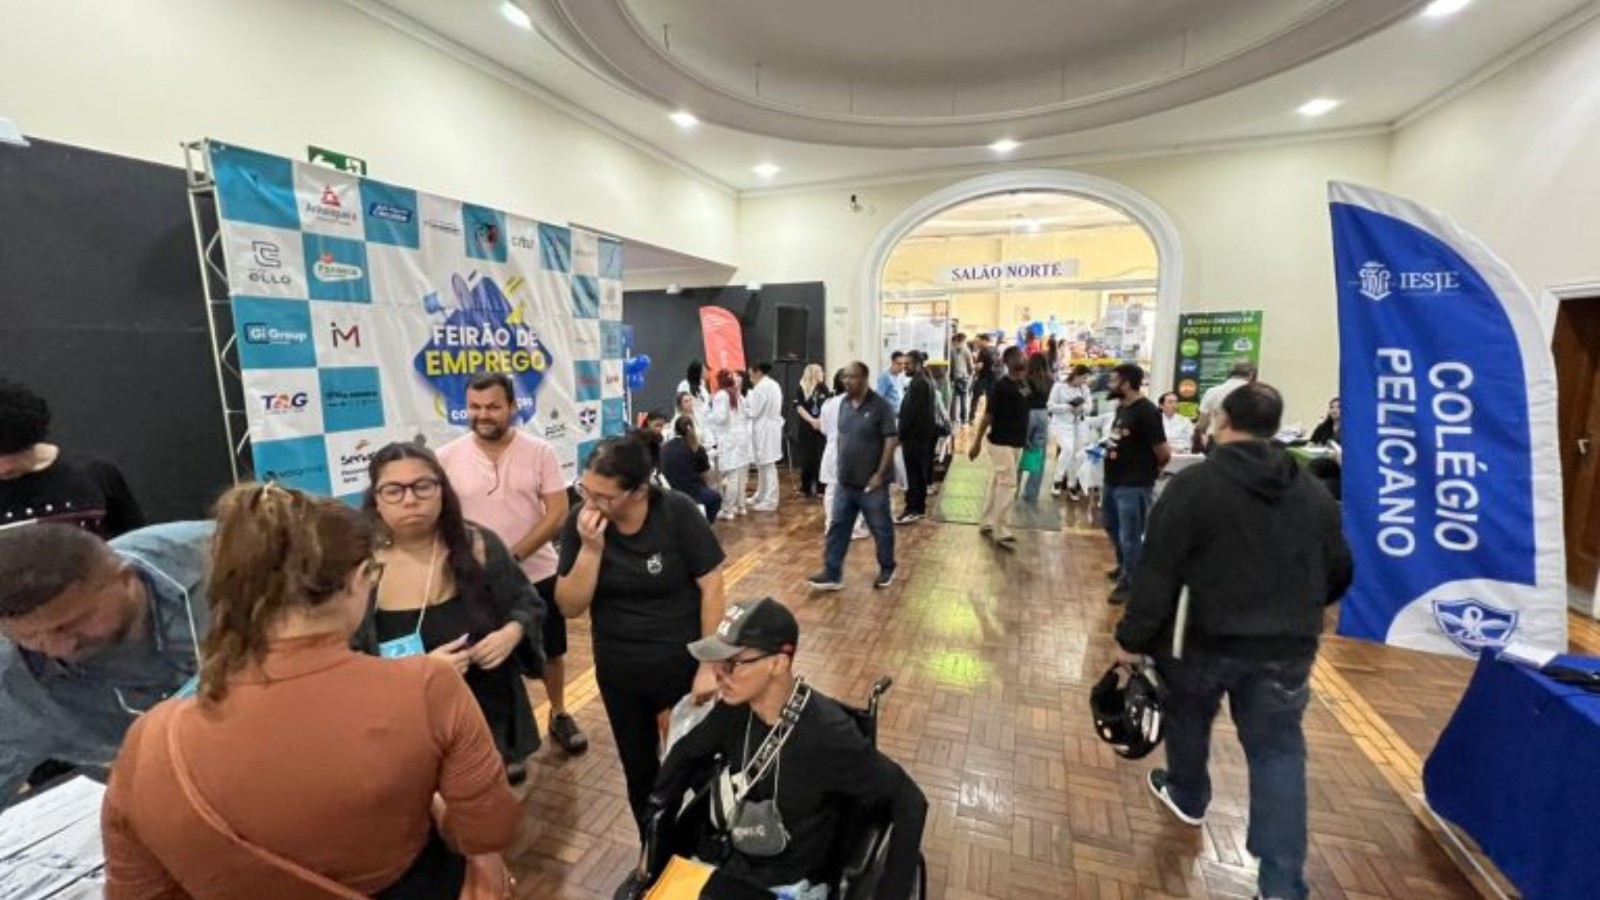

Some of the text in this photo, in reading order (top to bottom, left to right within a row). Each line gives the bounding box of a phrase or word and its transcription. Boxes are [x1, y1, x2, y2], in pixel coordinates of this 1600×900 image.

[951, 261, 1062, 281] SALÃO NORTE
[1400, 271, 1460, 292] IESJE
[268, 327, 308, 344] Group
[433, 322, 539, 348] FEIRÃO DE
[425, 349, 547, 376] EMPREGO
[1376, 347, 1418, 557] PELICANO
[1428, 361, 1489, 551] COLÉGIO
